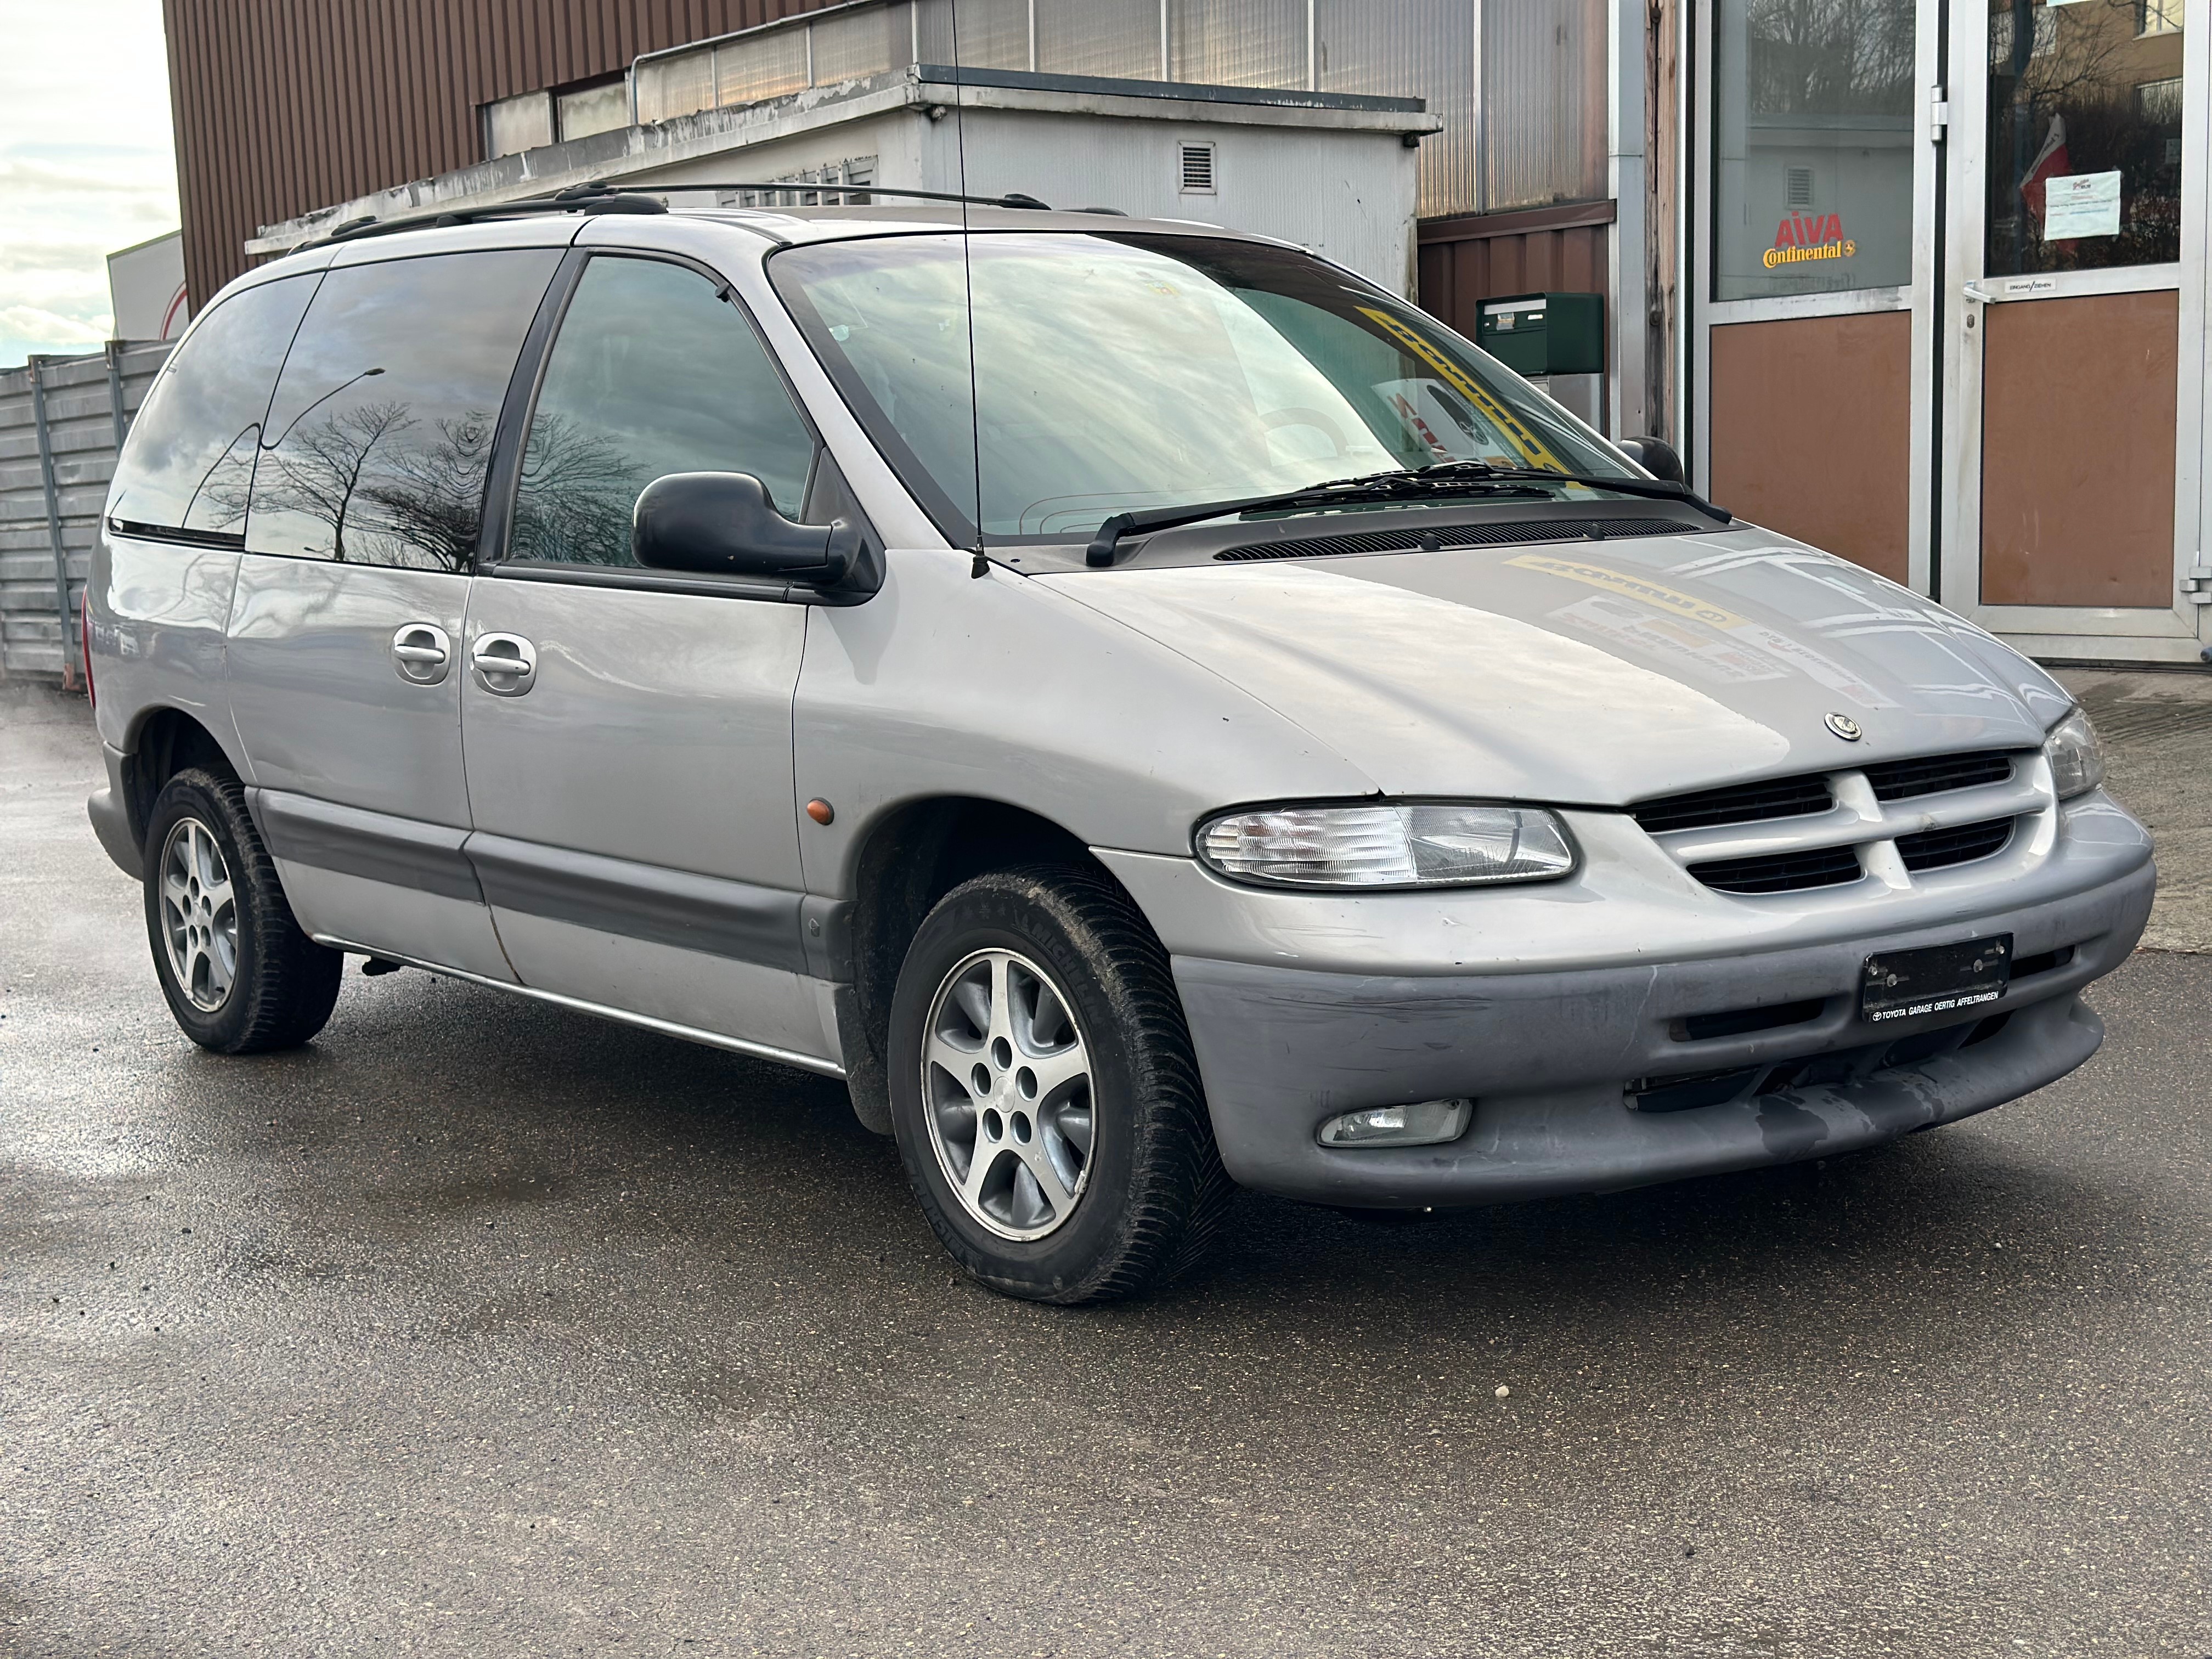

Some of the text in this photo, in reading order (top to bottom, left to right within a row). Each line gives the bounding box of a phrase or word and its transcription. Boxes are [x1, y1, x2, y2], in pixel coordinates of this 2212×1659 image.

[1763, 240, 1842, 268] Continental
[1882, 991, 1999, 1019] TOYOTA GARAGE OERTIG AFFELTRANGEN
